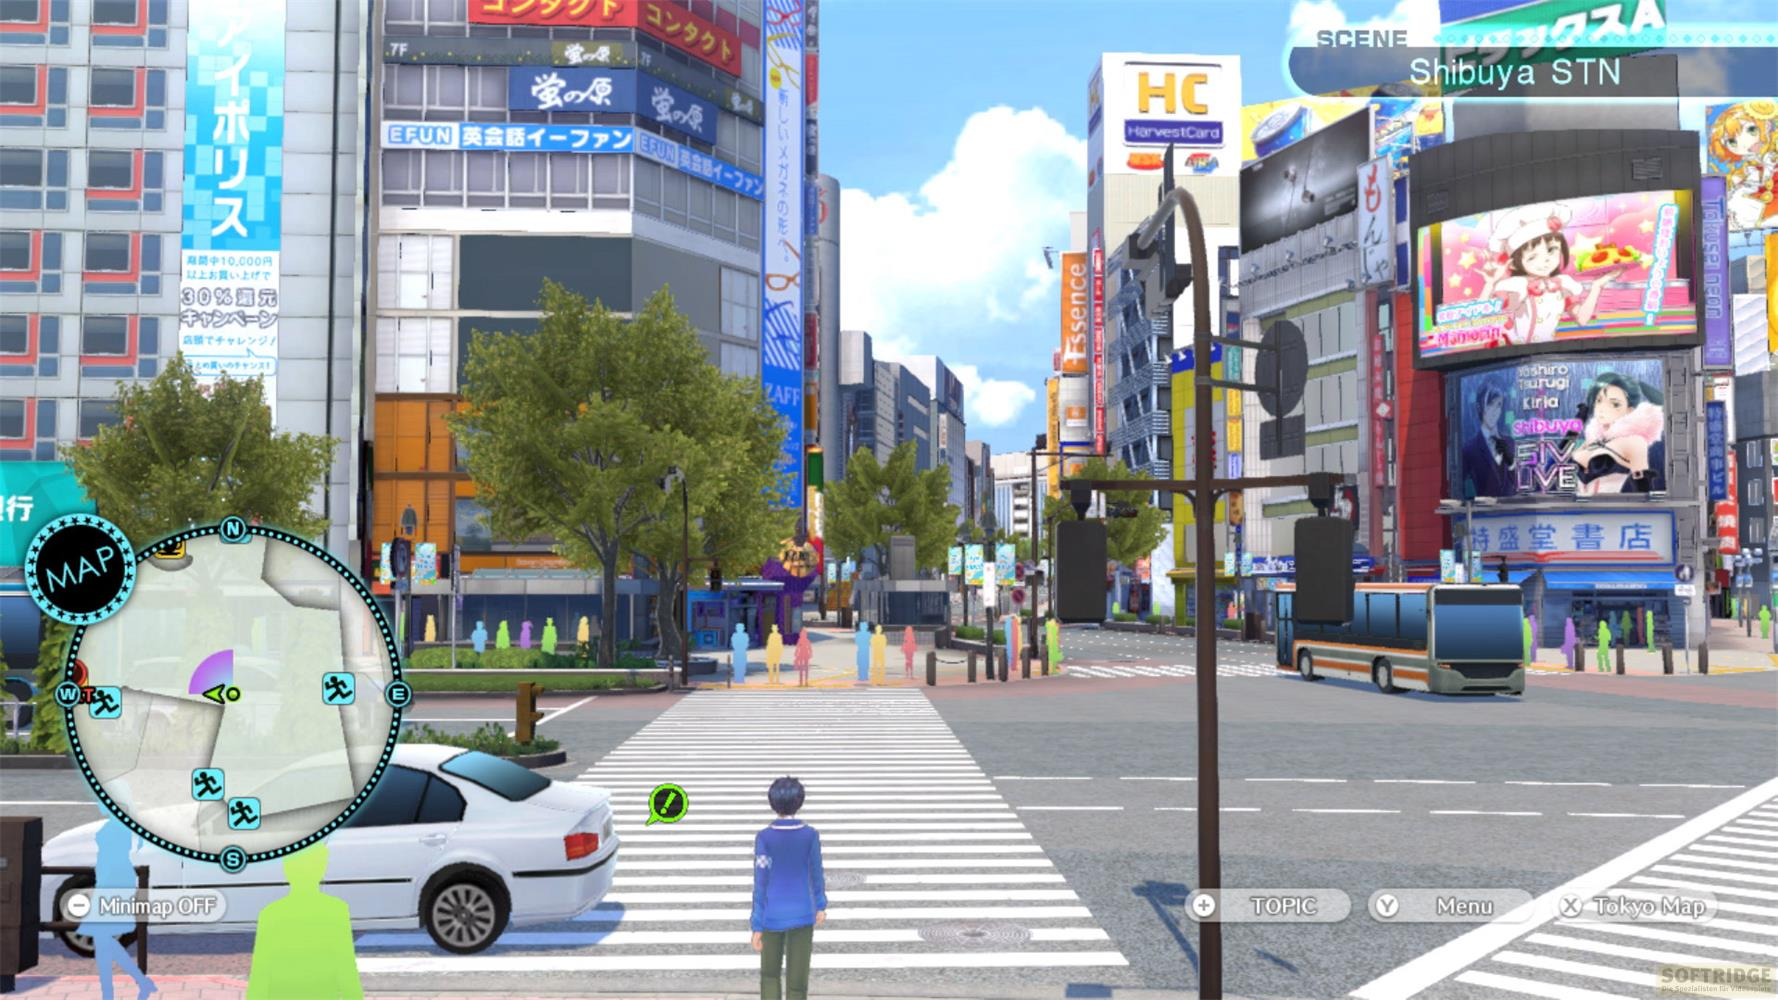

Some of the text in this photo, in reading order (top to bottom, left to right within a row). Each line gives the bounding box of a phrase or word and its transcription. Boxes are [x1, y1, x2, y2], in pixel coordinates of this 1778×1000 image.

[646, 3, 733, 62] コンタクト
[390, 43, 408, 57] 7F
[1138, 72, 1208, 115] HC
[390, 126, 452, 144] EFUN
[462, 126, 632, 150] 英会話イーファン
[1128, 125, 1220, 139] HarvestCard
[639, 132, 676, 164] EFUN
[180, 308, 279, 329] キャンペーン
[1064, 263, 1087, 365] Essence
[0, 496, 33, 521] 行
[1470, 523, 1652, 552] 特盛堂書店
